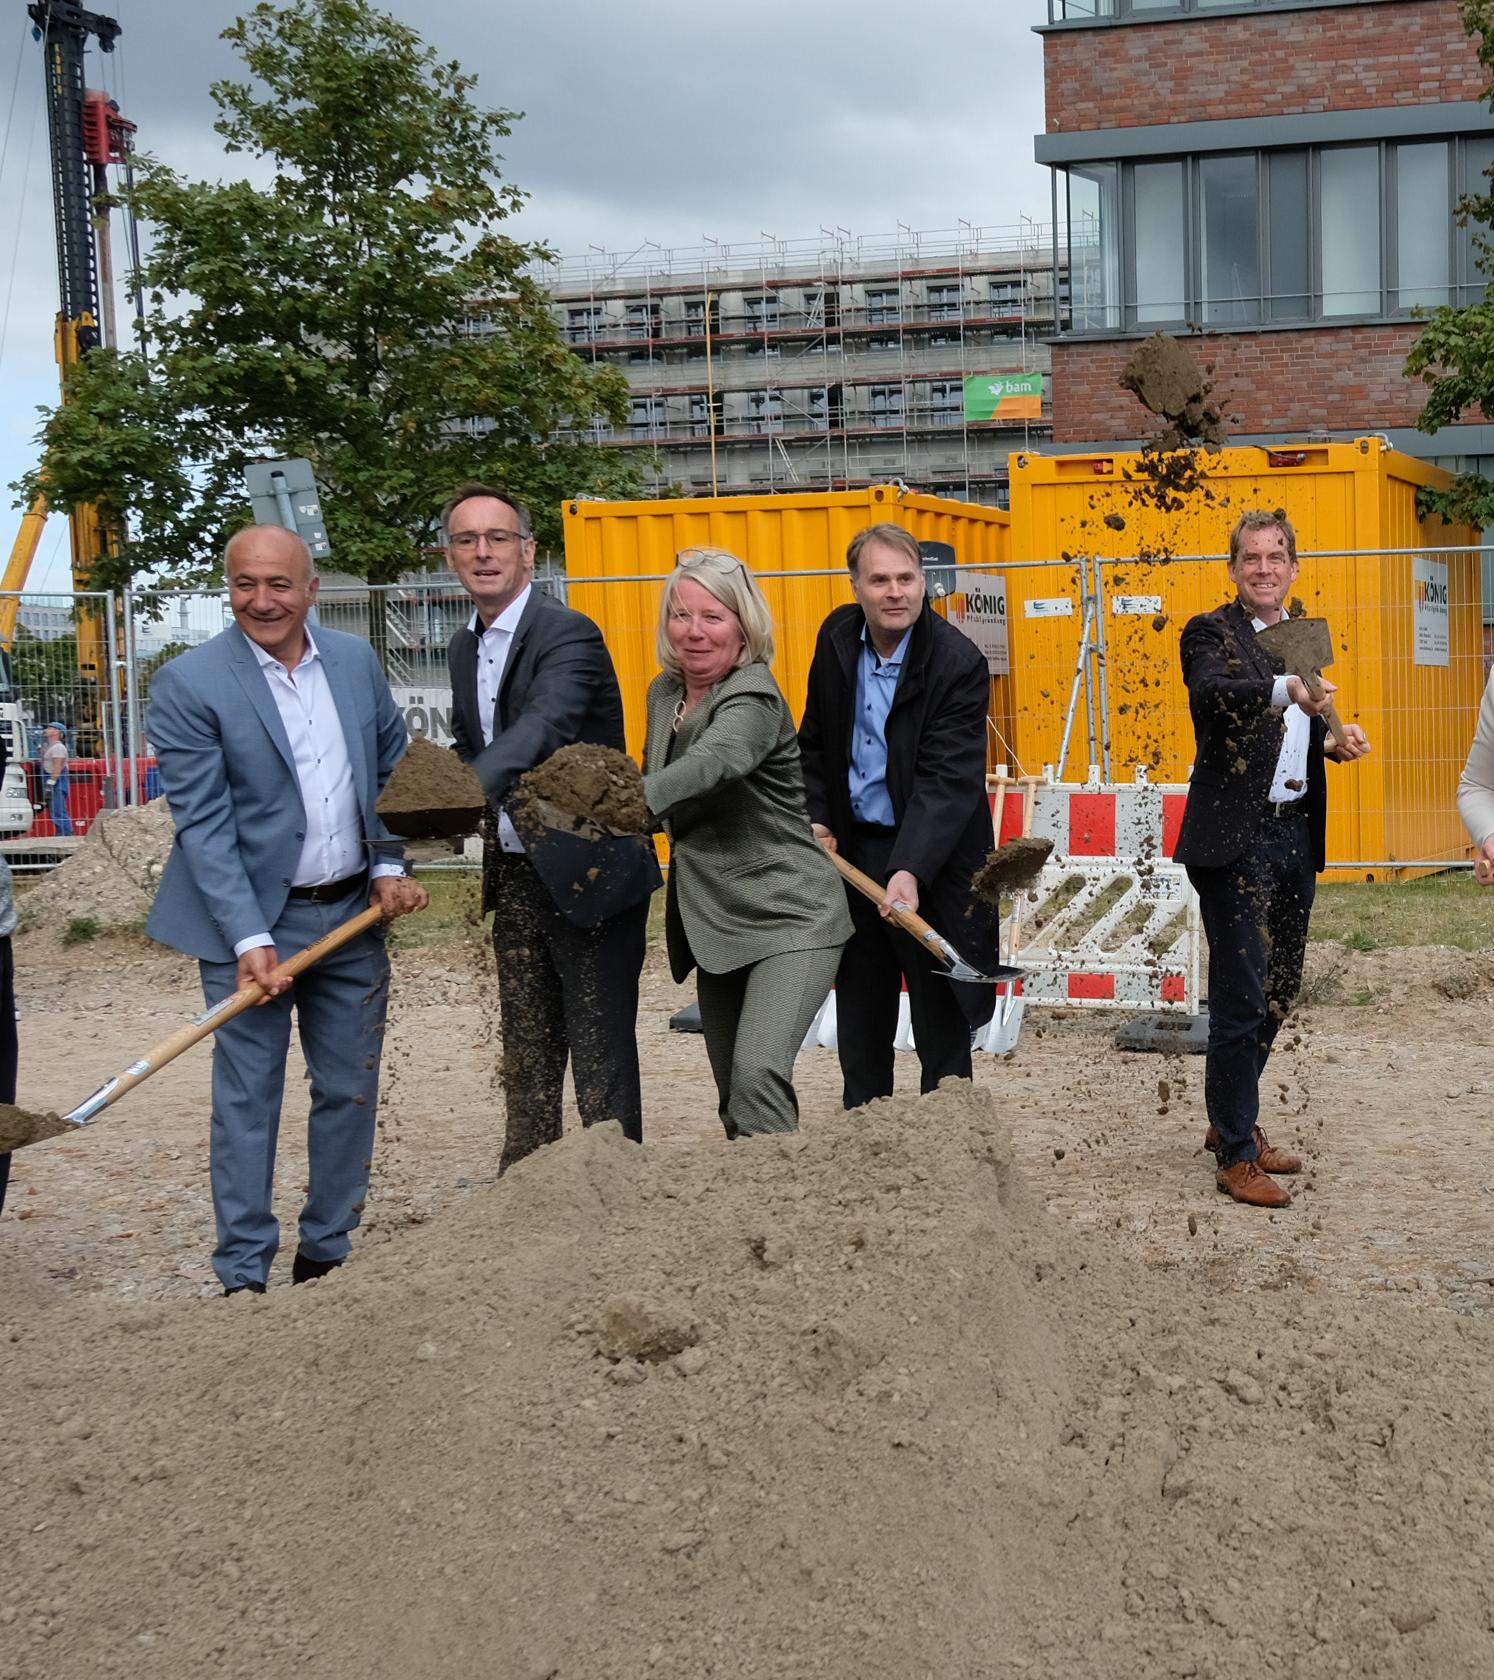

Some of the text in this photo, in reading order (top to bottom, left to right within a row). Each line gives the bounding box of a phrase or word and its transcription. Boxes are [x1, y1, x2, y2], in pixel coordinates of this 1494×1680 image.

[1006, 381, 1032, 393] bam
[965, 587, 1005, 615] KÖNIG
[1424, 576, 1447, 605] KÖNIG
[399, 696, 453, 738] ÖN
